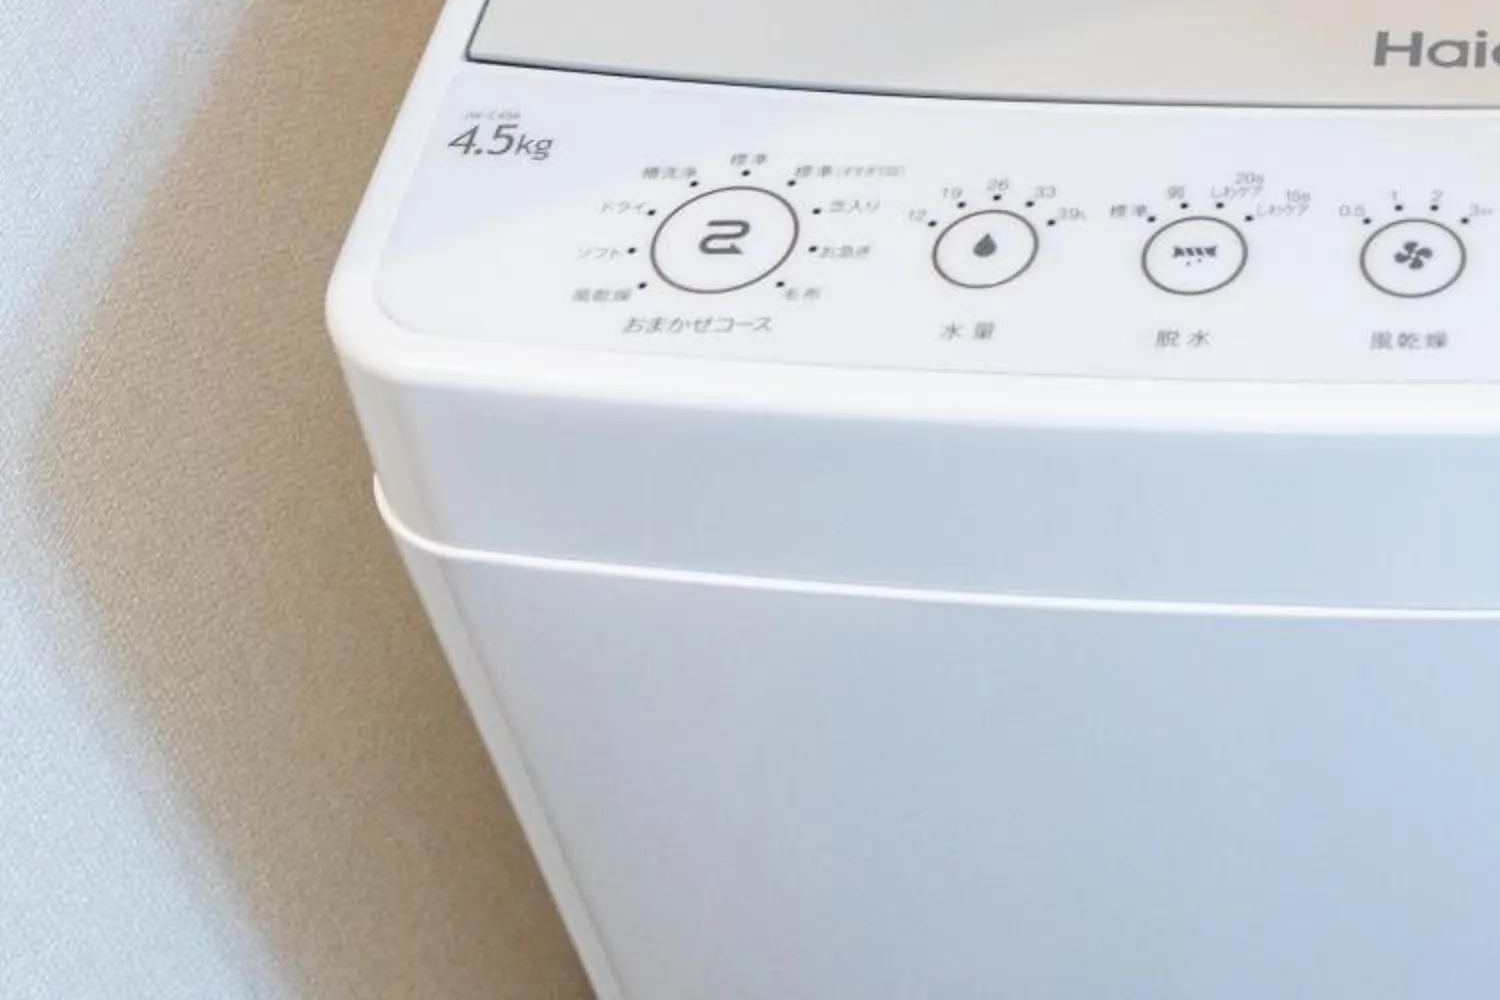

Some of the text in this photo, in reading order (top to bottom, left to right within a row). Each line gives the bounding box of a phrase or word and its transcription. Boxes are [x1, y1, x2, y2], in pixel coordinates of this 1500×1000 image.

[448, 123, 553, 160] 4.5kg
[987, 179, 1009, 192] 26
[1034, 185, 1056, 198] 33
[943, 188, 962, 199] 19
[1390, 190, 1399, 202] 1
[1431, 190, 1444, 202] 2
[909, 209, 926, 221] 12
[1340, 205, 1366, 218] 0.5
[622, 316, 772, 333] おまかせコース
[1155, 329, 1210, 347] 脱水
[1371, 331, 1447, 350] 風乾燥
